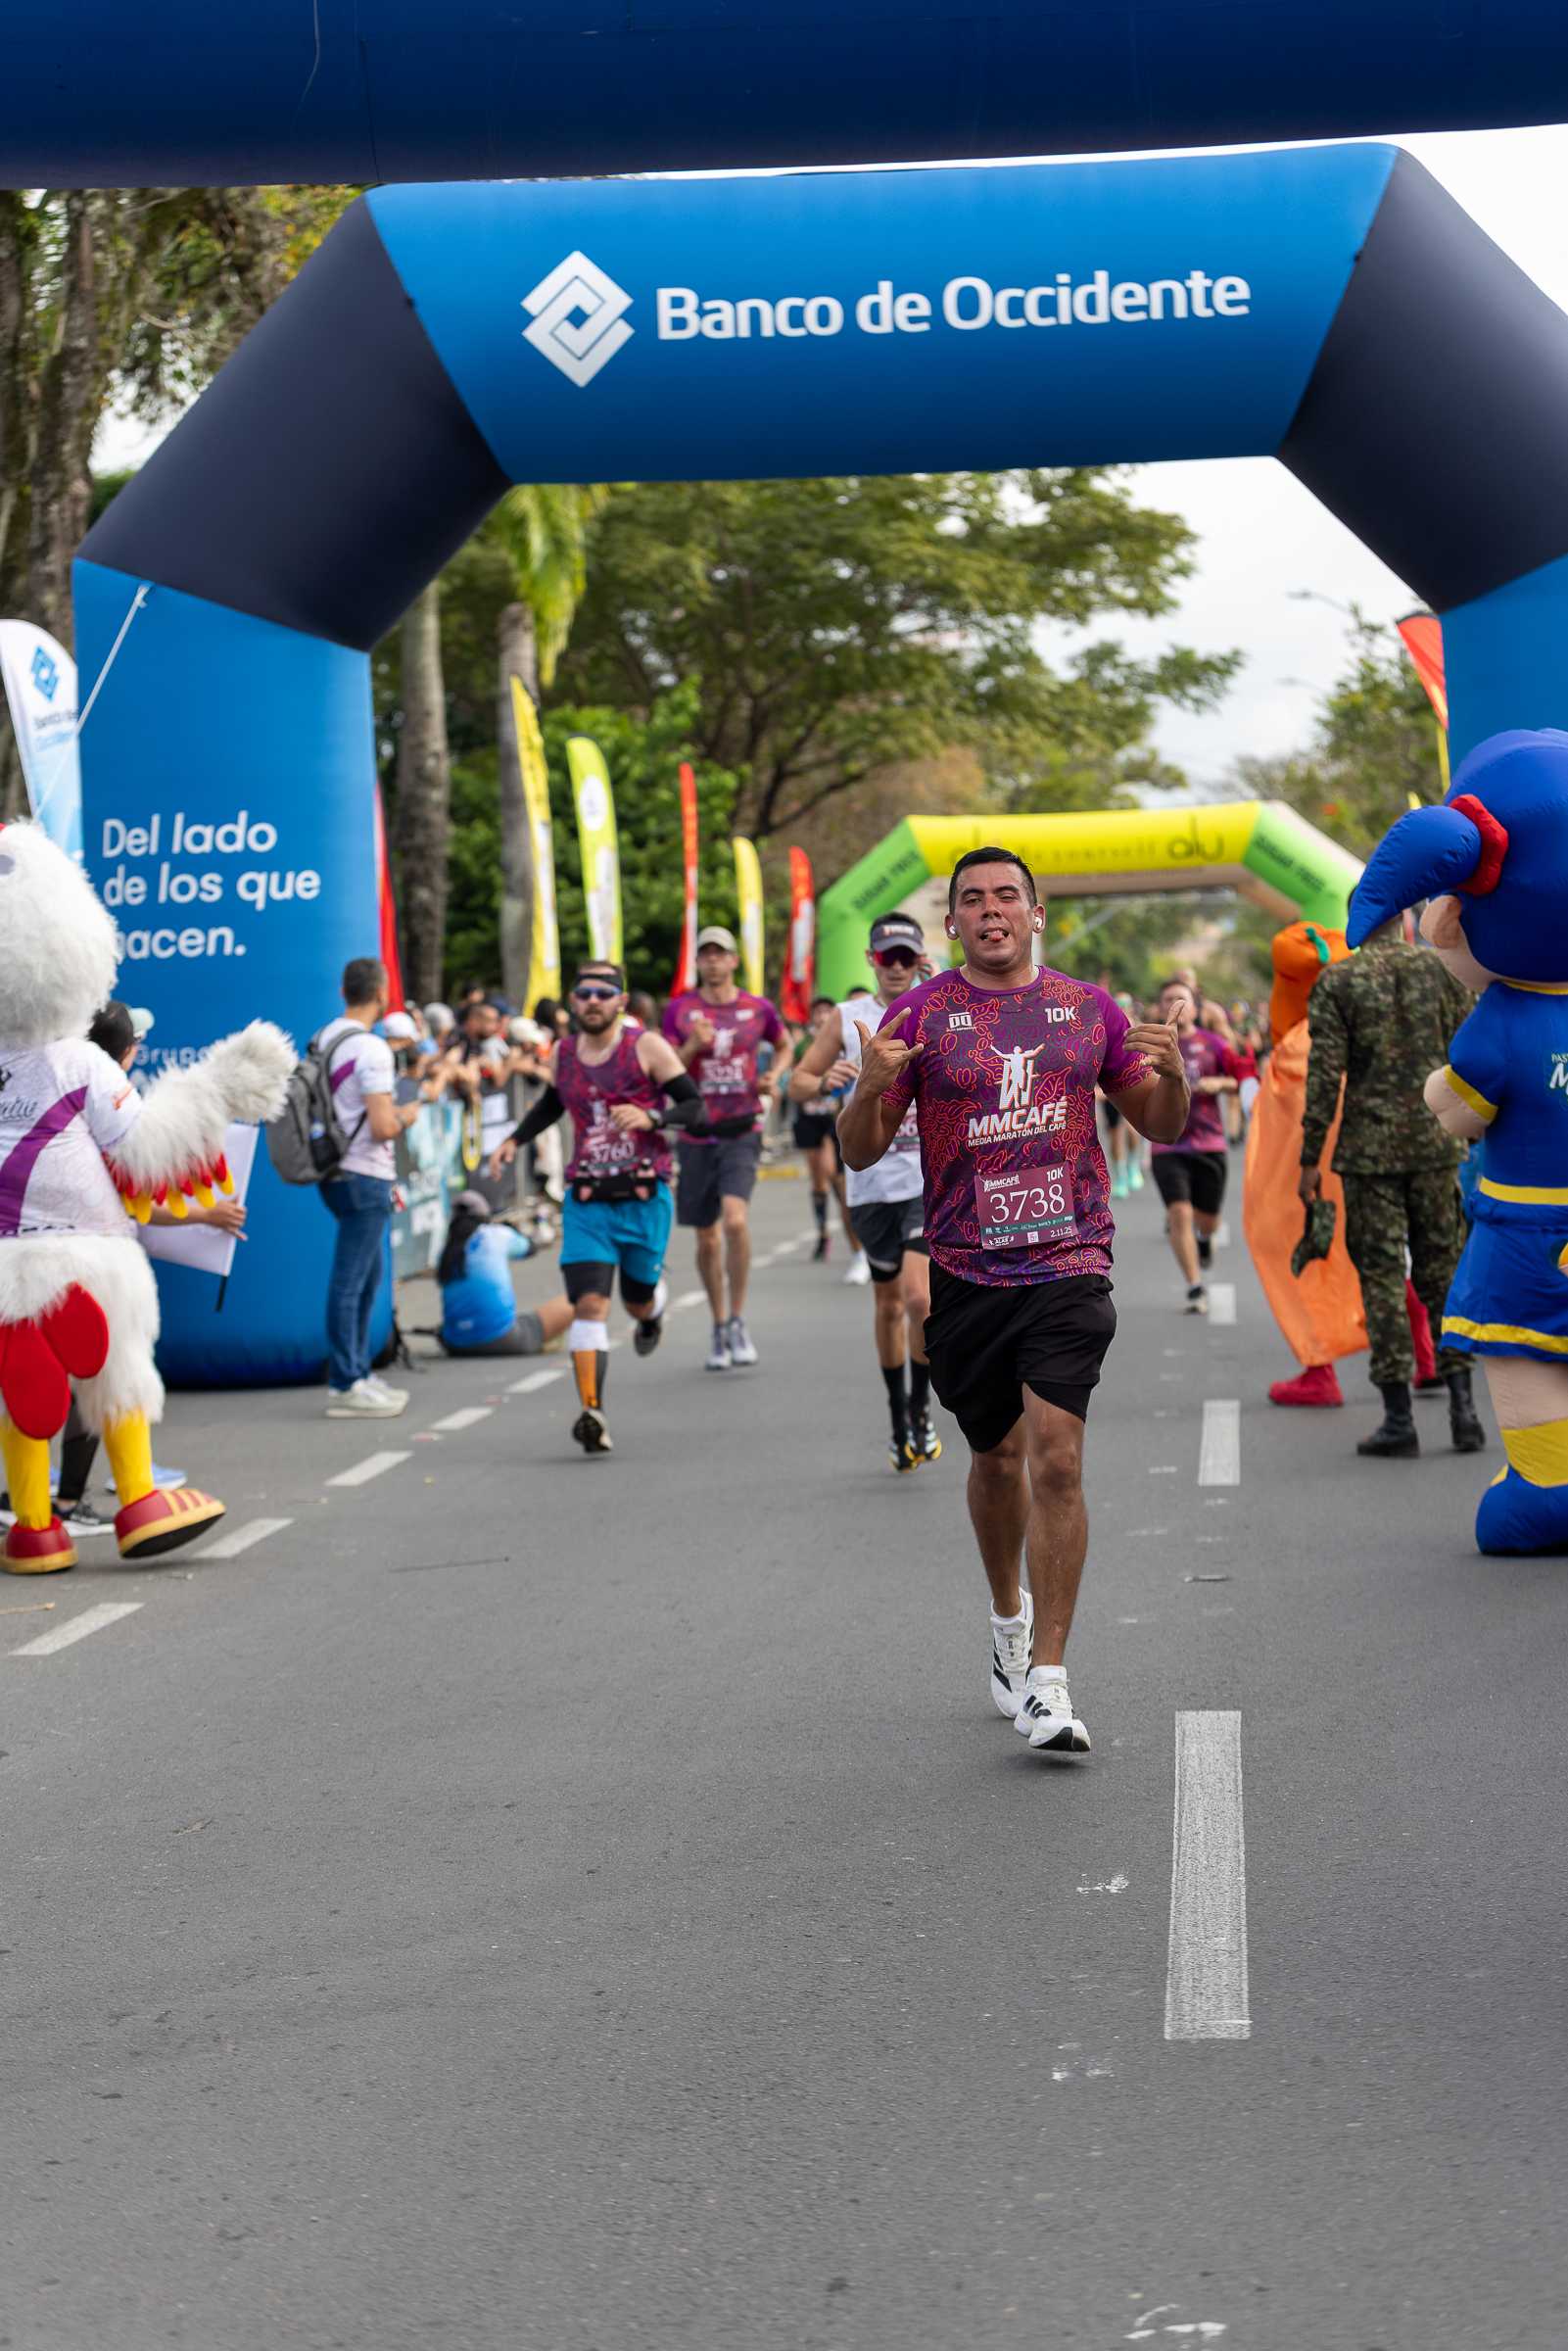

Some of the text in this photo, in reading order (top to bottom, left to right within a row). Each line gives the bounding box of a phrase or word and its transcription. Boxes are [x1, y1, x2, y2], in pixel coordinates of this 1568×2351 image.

[655, 268, 1252, 340] Banco de Occidente
[102, 809, 278, 859] Del lado
[103, 861, 321, 912] de los que
[1044, 1006, 1076, 1024] 10K
[968, 1134, 992, 1148] MEDIA
[1033, 1125, 1048, 1134] DEL
[969, 1095, 1068, 1138] MMCAFÉ
[1046, 1166, 1065, 1182] 10K
[989, 1183, 1066, 1224] 3738
[1050, 1225, 1073, 1238] 2.11.25
